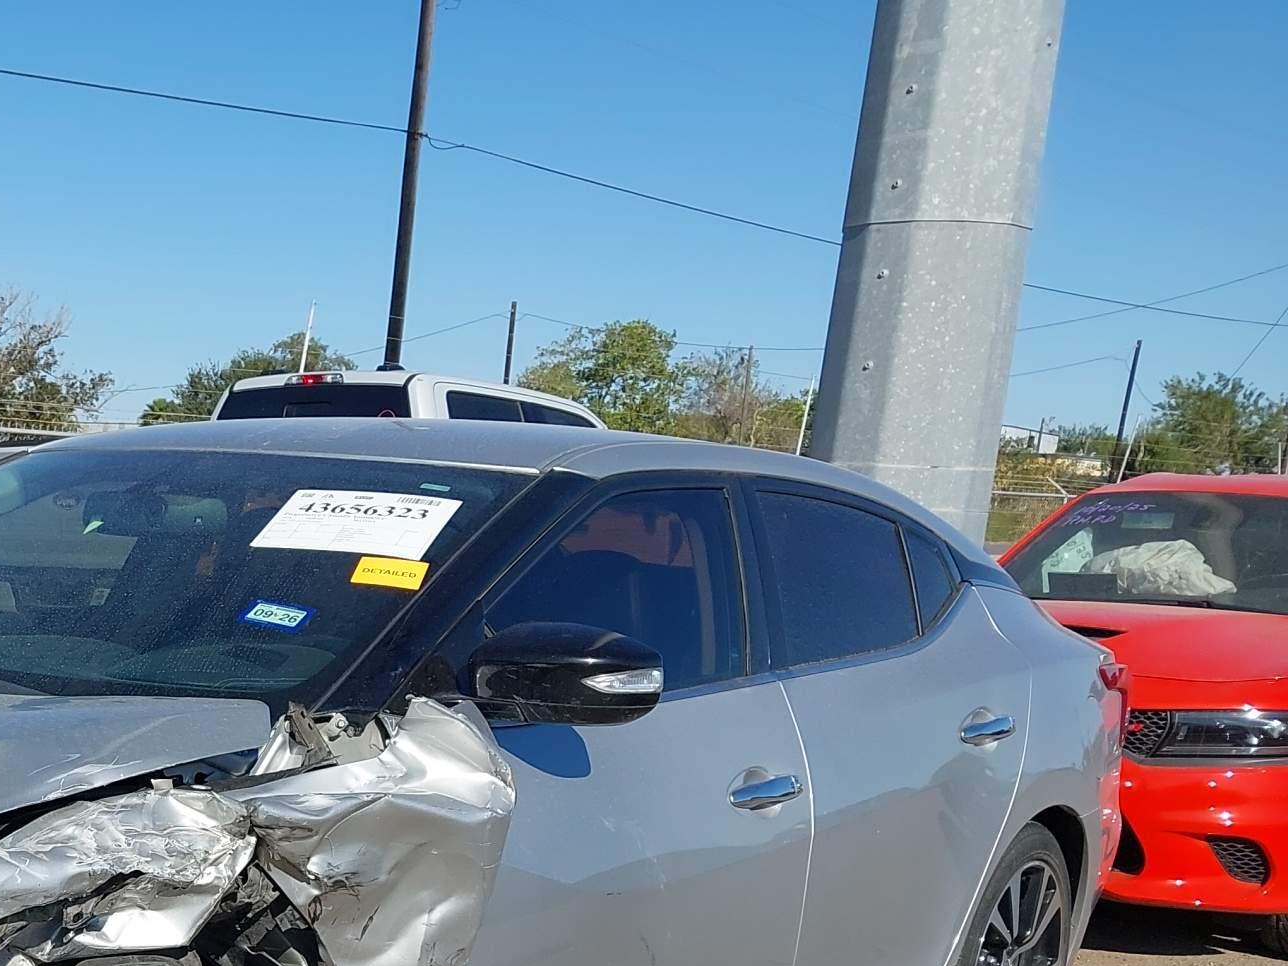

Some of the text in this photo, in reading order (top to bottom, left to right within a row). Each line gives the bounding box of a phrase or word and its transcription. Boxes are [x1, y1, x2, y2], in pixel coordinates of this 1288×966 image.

[298, 502, 430, 521] 43656323
[361, 567, 417, 579] DETAILED
[253, 608, 274, 618] 09
[278, 613, 300, 623] 26
